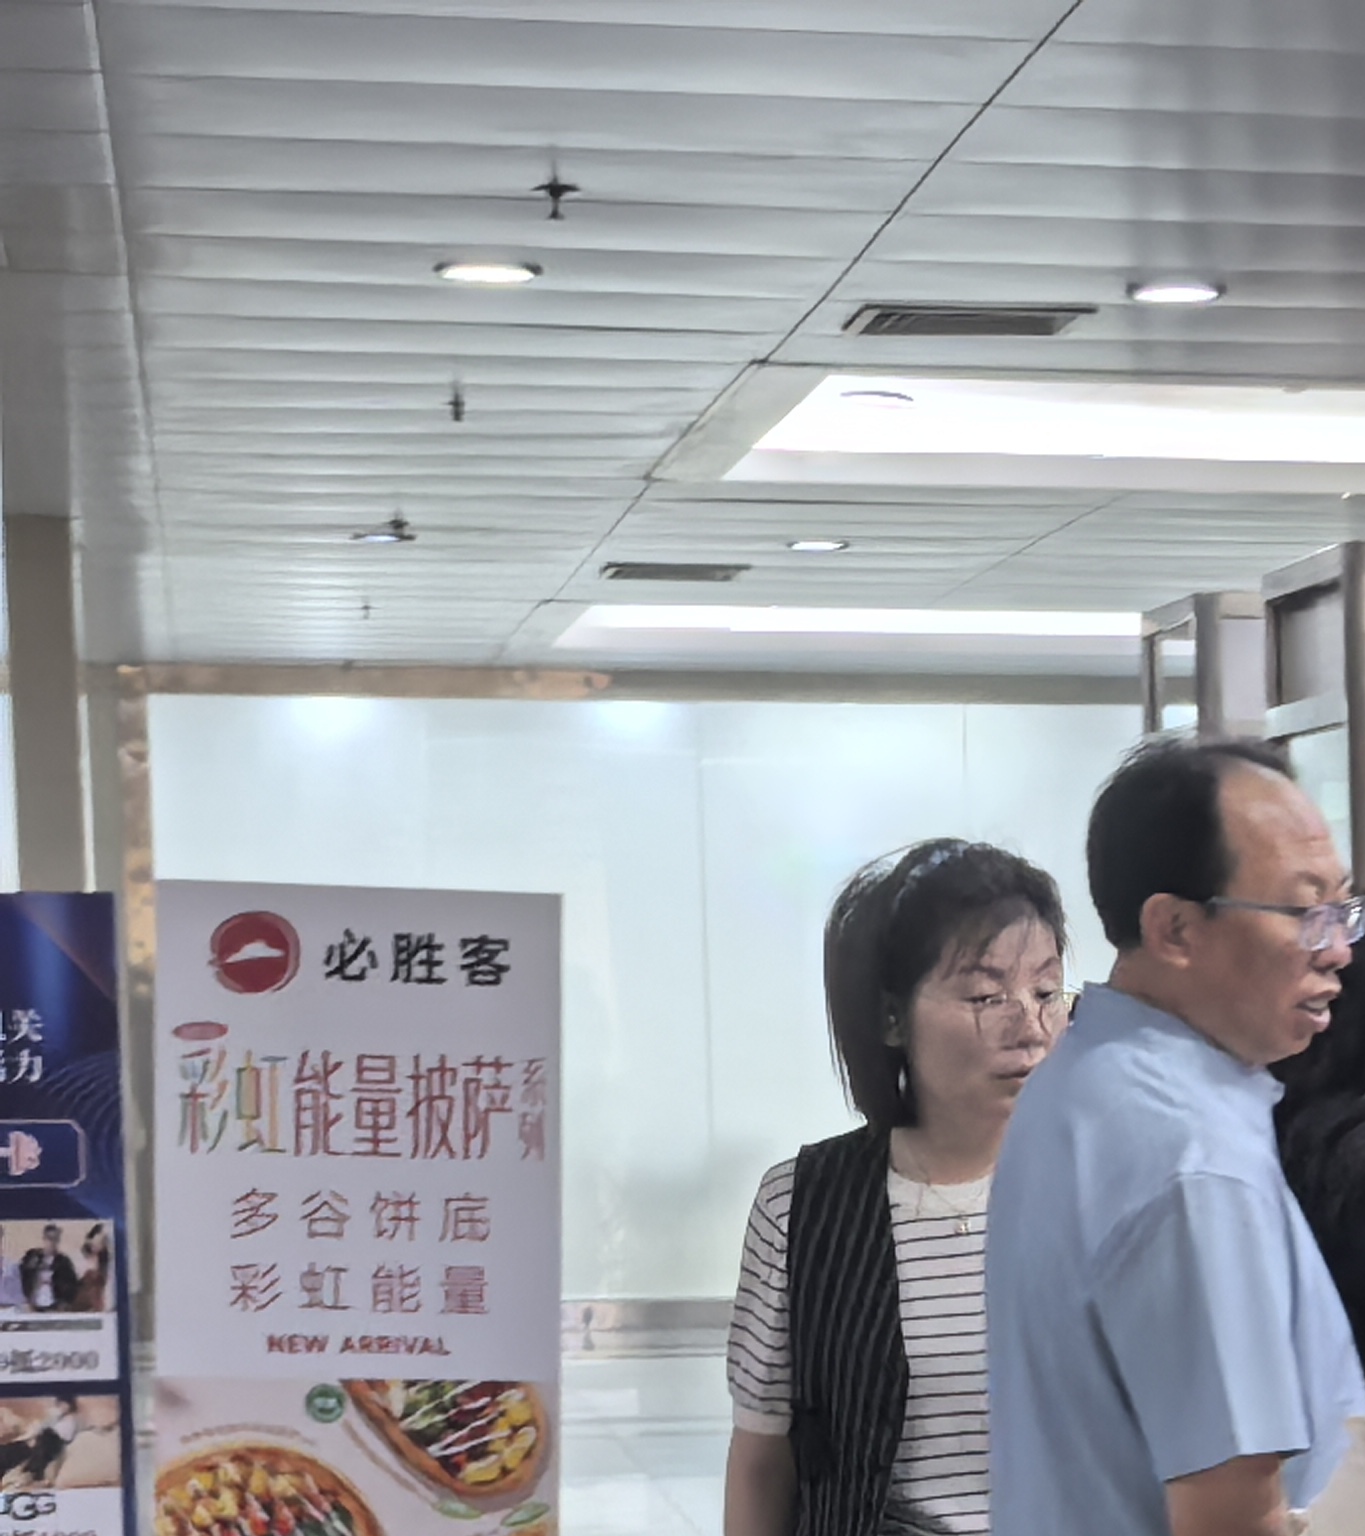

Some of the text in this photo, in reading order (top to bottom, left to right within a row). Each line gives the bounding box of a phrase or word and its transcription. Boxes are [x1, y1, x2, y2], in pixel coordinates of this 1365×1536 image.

[323, 928, 511, 986] 必胜客
[0, 1048, 43, 1085] 力
[178, 1047, 513, 1161] 彩虹能量披萨
[231, 1187, 491, 1242] 多谷饼底
[230, 1262, 489, 1315] 彩虹能量
[266, 1333, 451, 1356] NEW ARRIVAL
